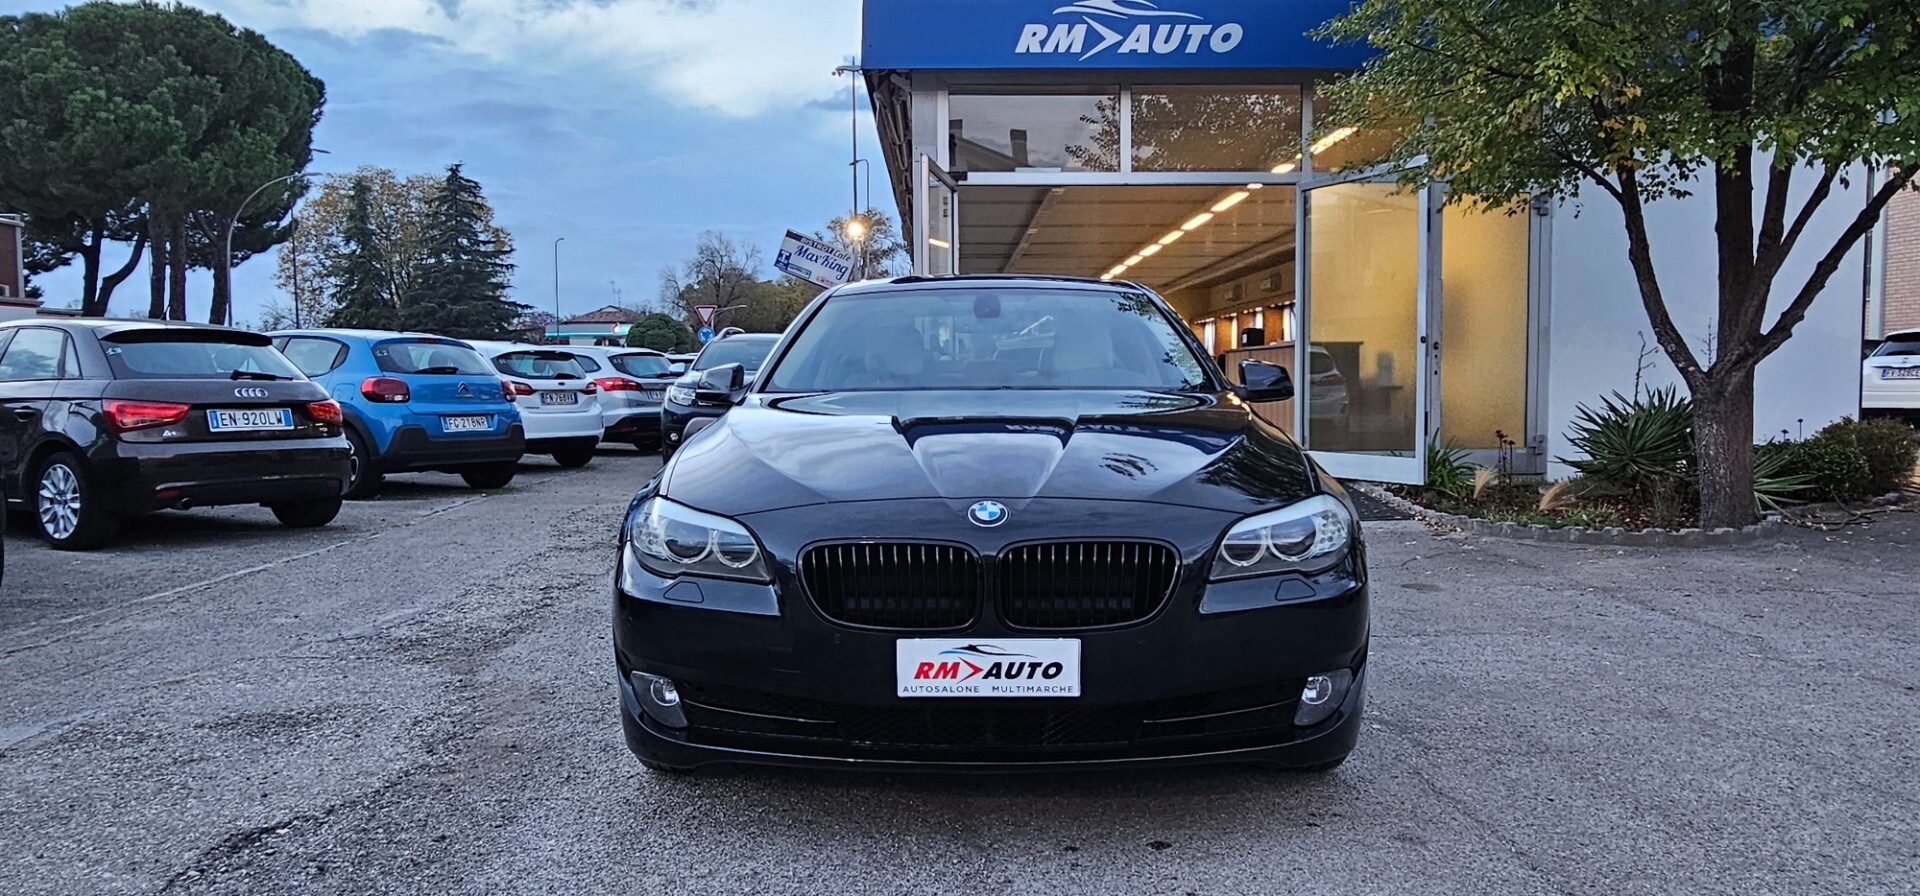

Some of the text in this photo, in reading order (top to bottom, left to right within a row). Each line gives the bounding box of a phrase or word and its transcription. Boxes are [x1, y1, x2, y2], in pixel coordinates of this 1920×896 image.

[1014, 22, 1244, 54] RM AUTO
[800, 237, 833, 254] BISTROT
[219, 411, 283, 427] EN 920LW
[914, 661, 1064, 680] RM AUTO
[902, 685, 1074, 694] AUTOSALONE MULTIMARCHE
